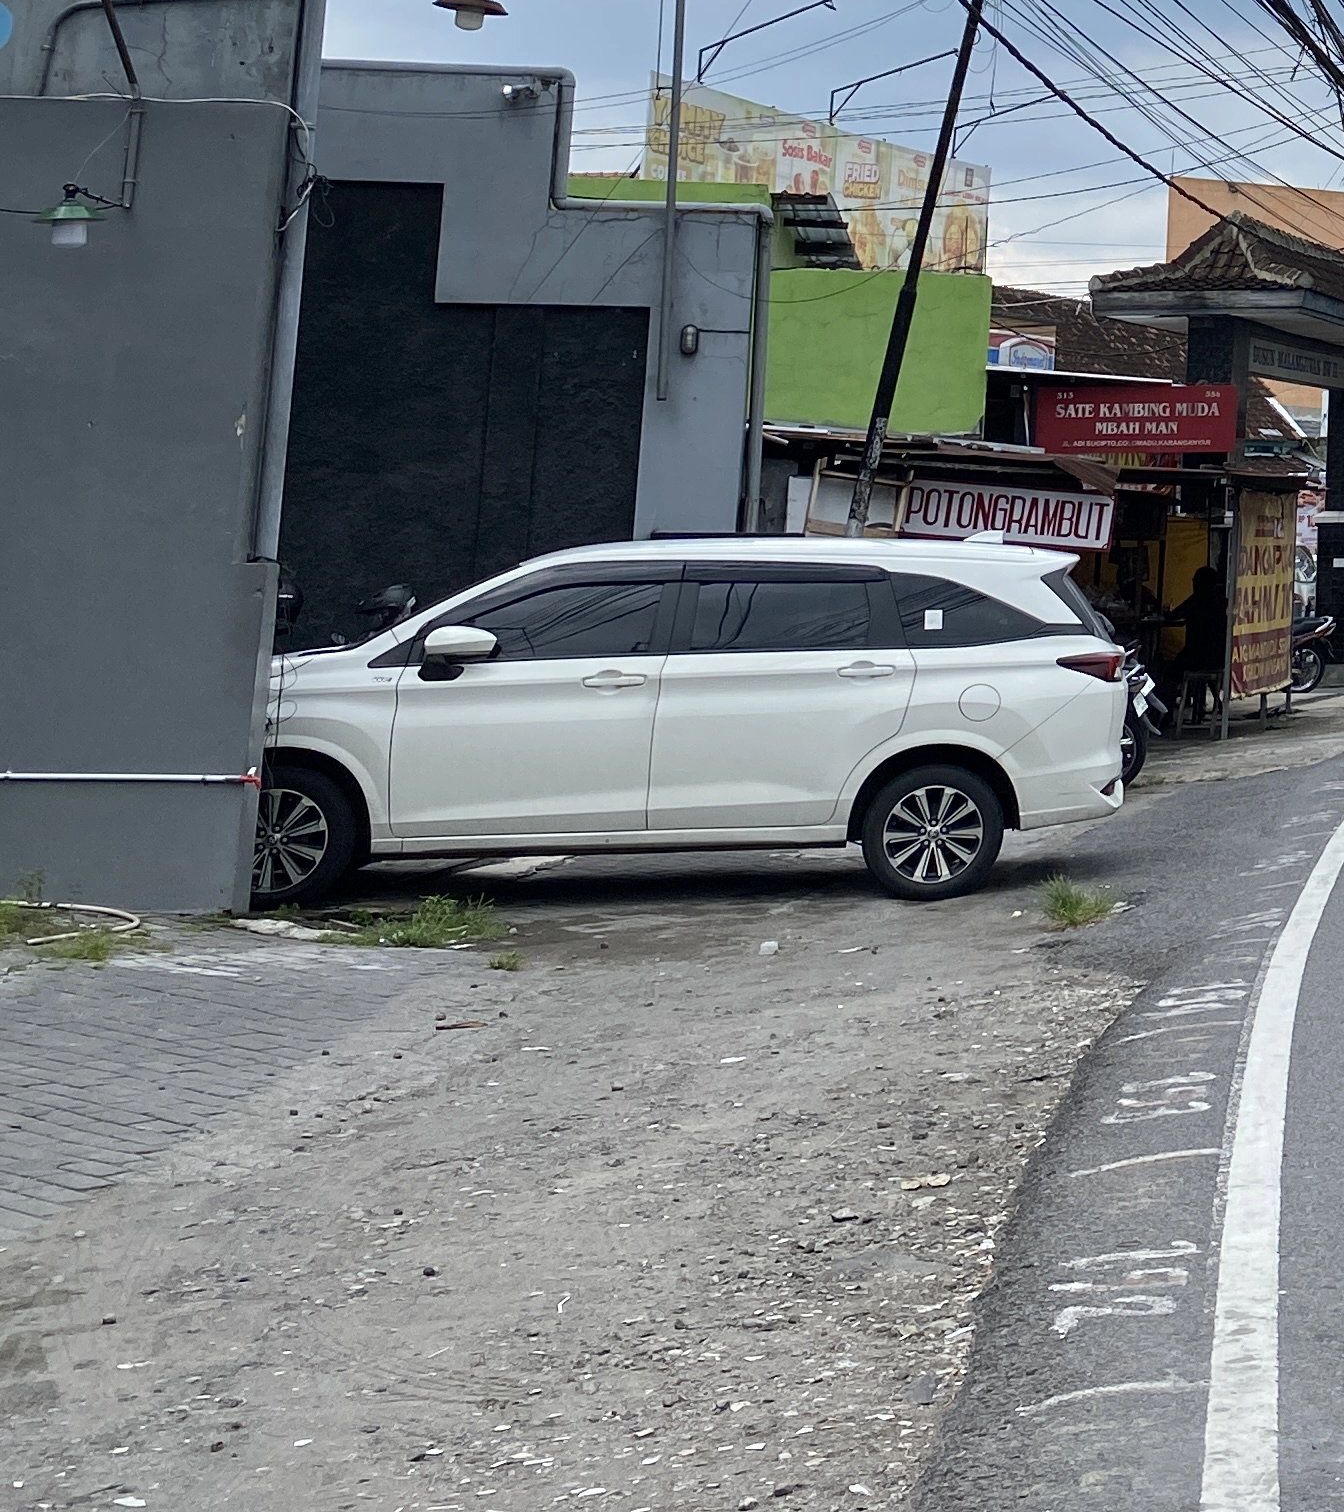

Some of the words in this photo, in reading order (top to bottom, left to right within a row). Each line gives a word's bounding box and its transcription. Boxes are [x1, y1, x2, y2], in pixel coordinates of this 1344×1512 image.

[782, 139, 805, 160] Sosis
[806, 145, 833, 169] Bakar
[845, 162, 880, 184] FRIED
[843, 182, 882, 199] CHICKEN
[1055, 403, 1095, 418] SATE
[1099, 402, 1171, 417] KAMBING
[1175, 402, 1220, 417] MUDA
[1095, 422, 1140, 434] MBAH
[1144, 422, 1178, 434] MAN
